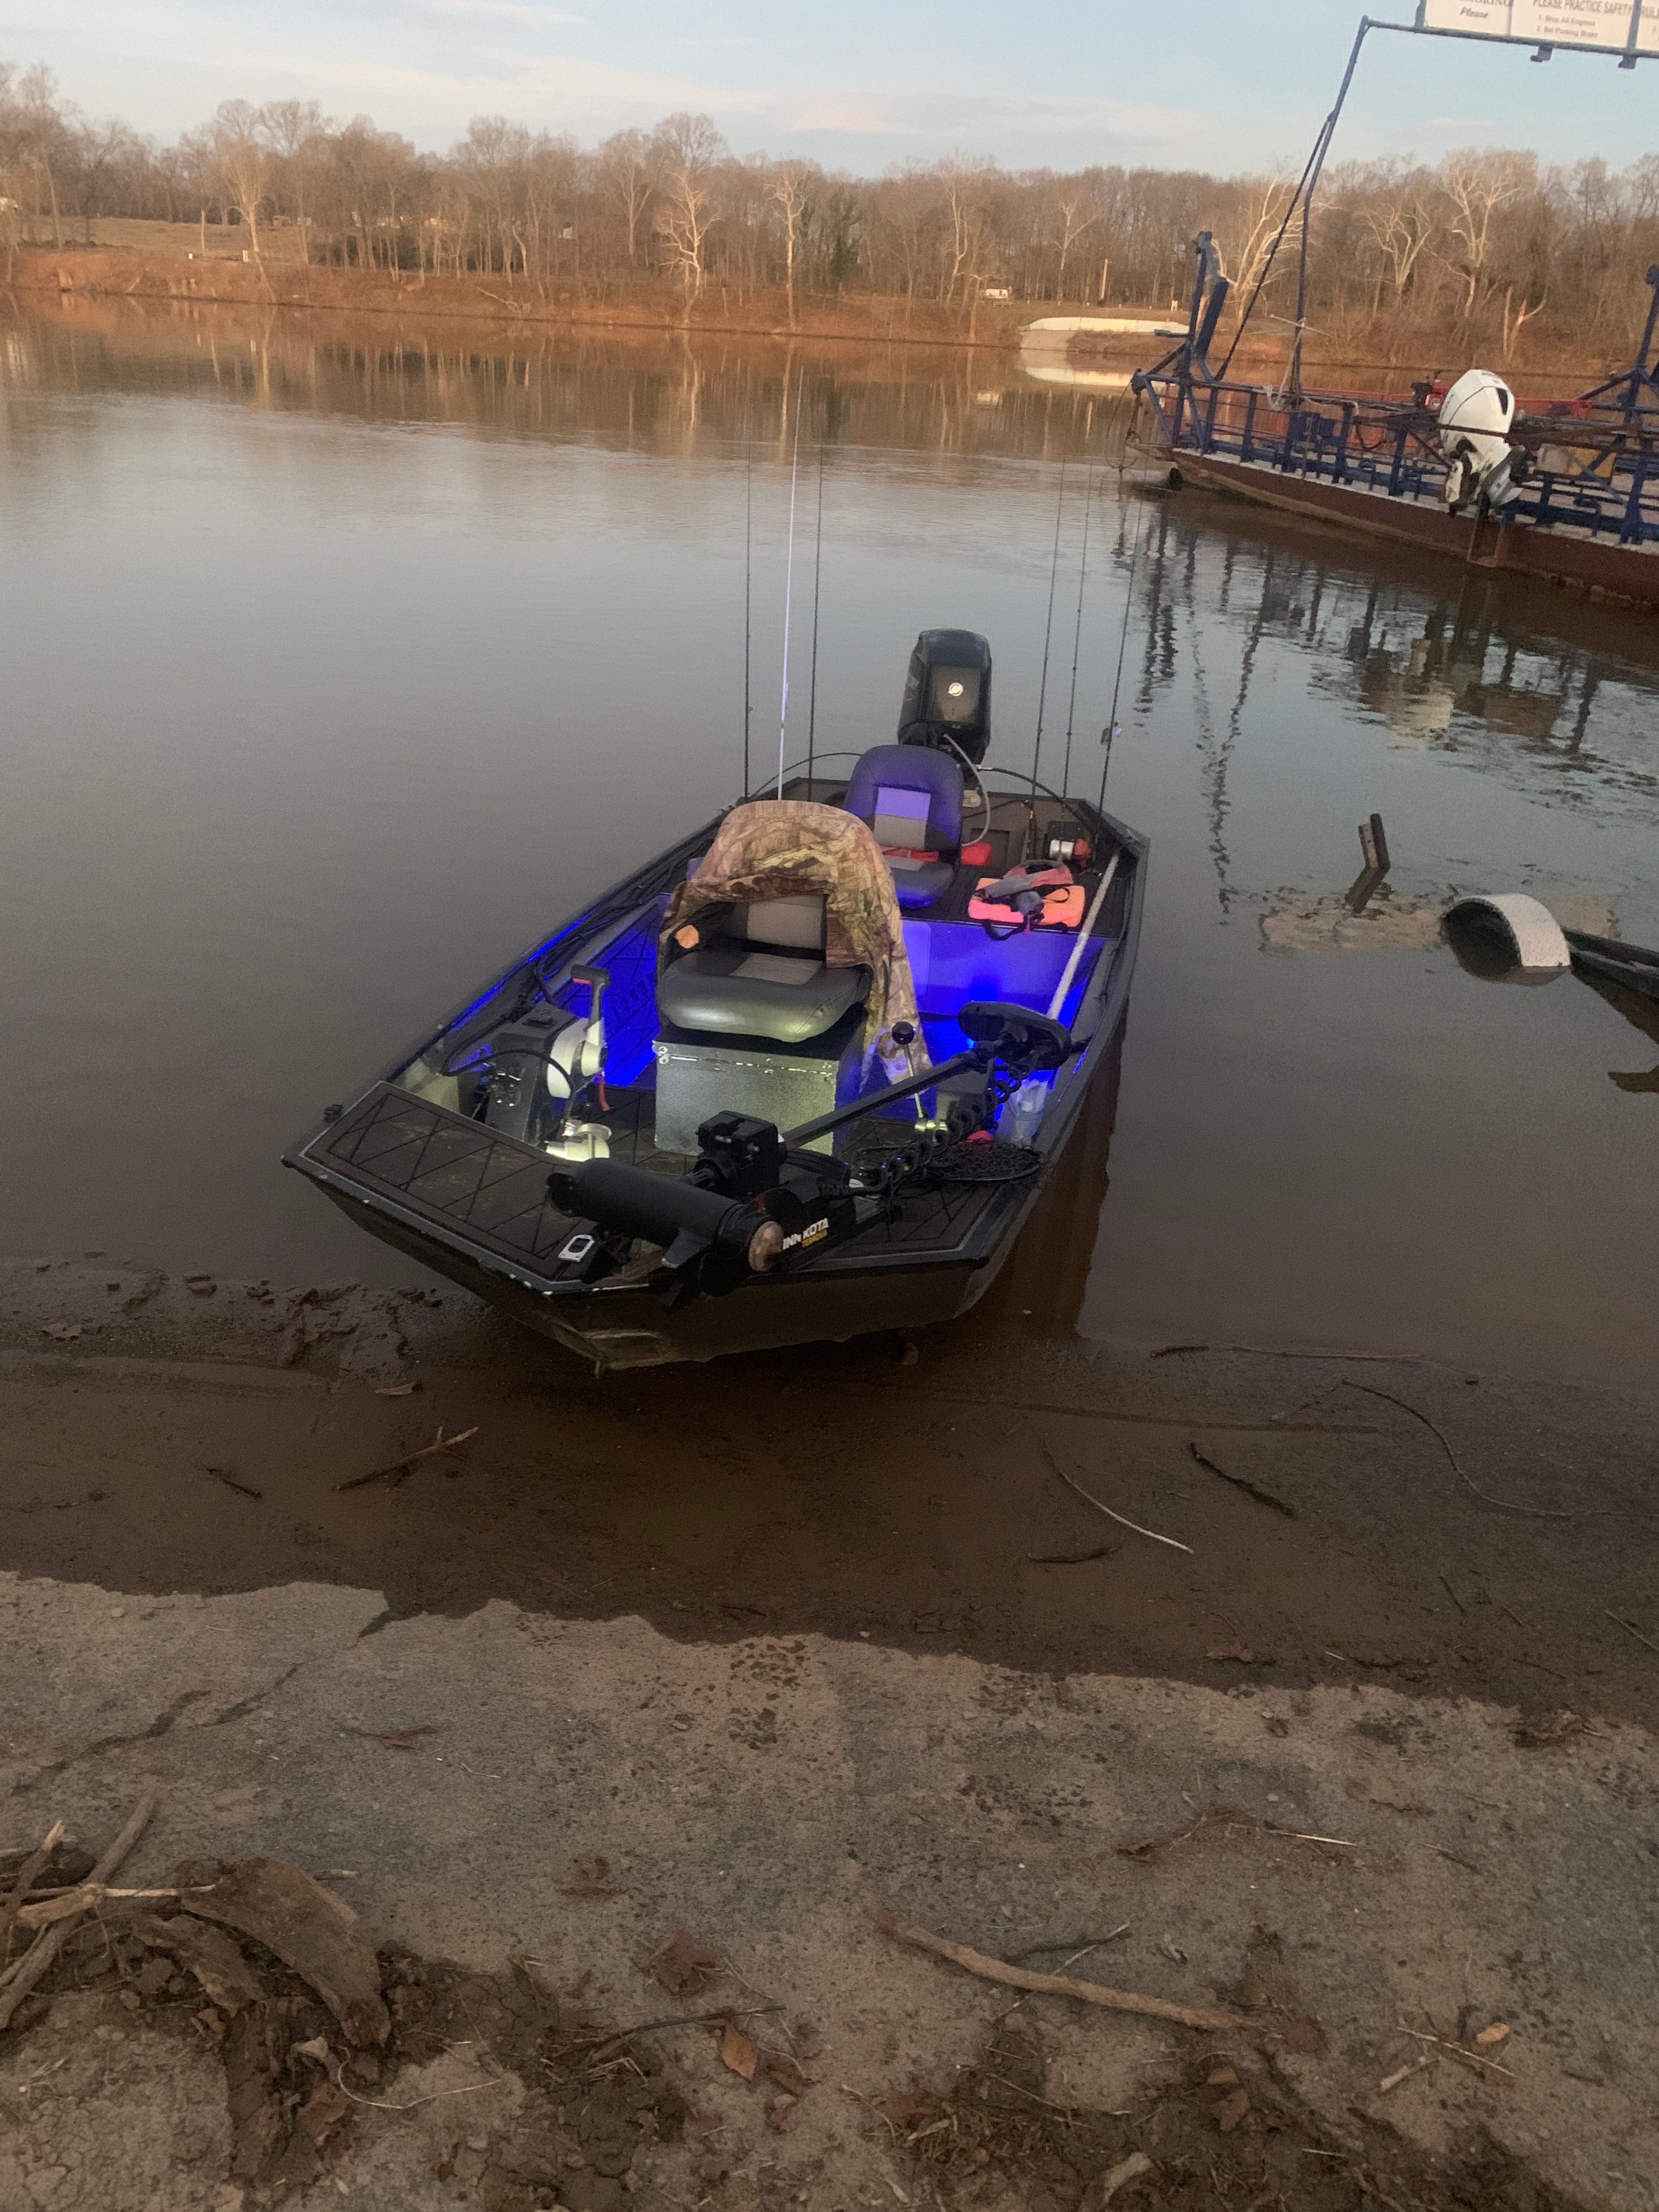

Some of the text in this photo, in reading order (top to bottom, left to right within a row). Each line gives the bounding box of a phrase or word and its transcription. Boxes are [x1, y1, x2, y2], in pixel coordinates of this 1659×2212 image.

[1460, 7, 1488, 18] Please
[1565, 0, 1601, 12] PRACTICE
[1642, 6, 1659, 18] RUL
[783, 1233, 802, 1250] INN
[802, 1218, 830, 1240] KOTA
